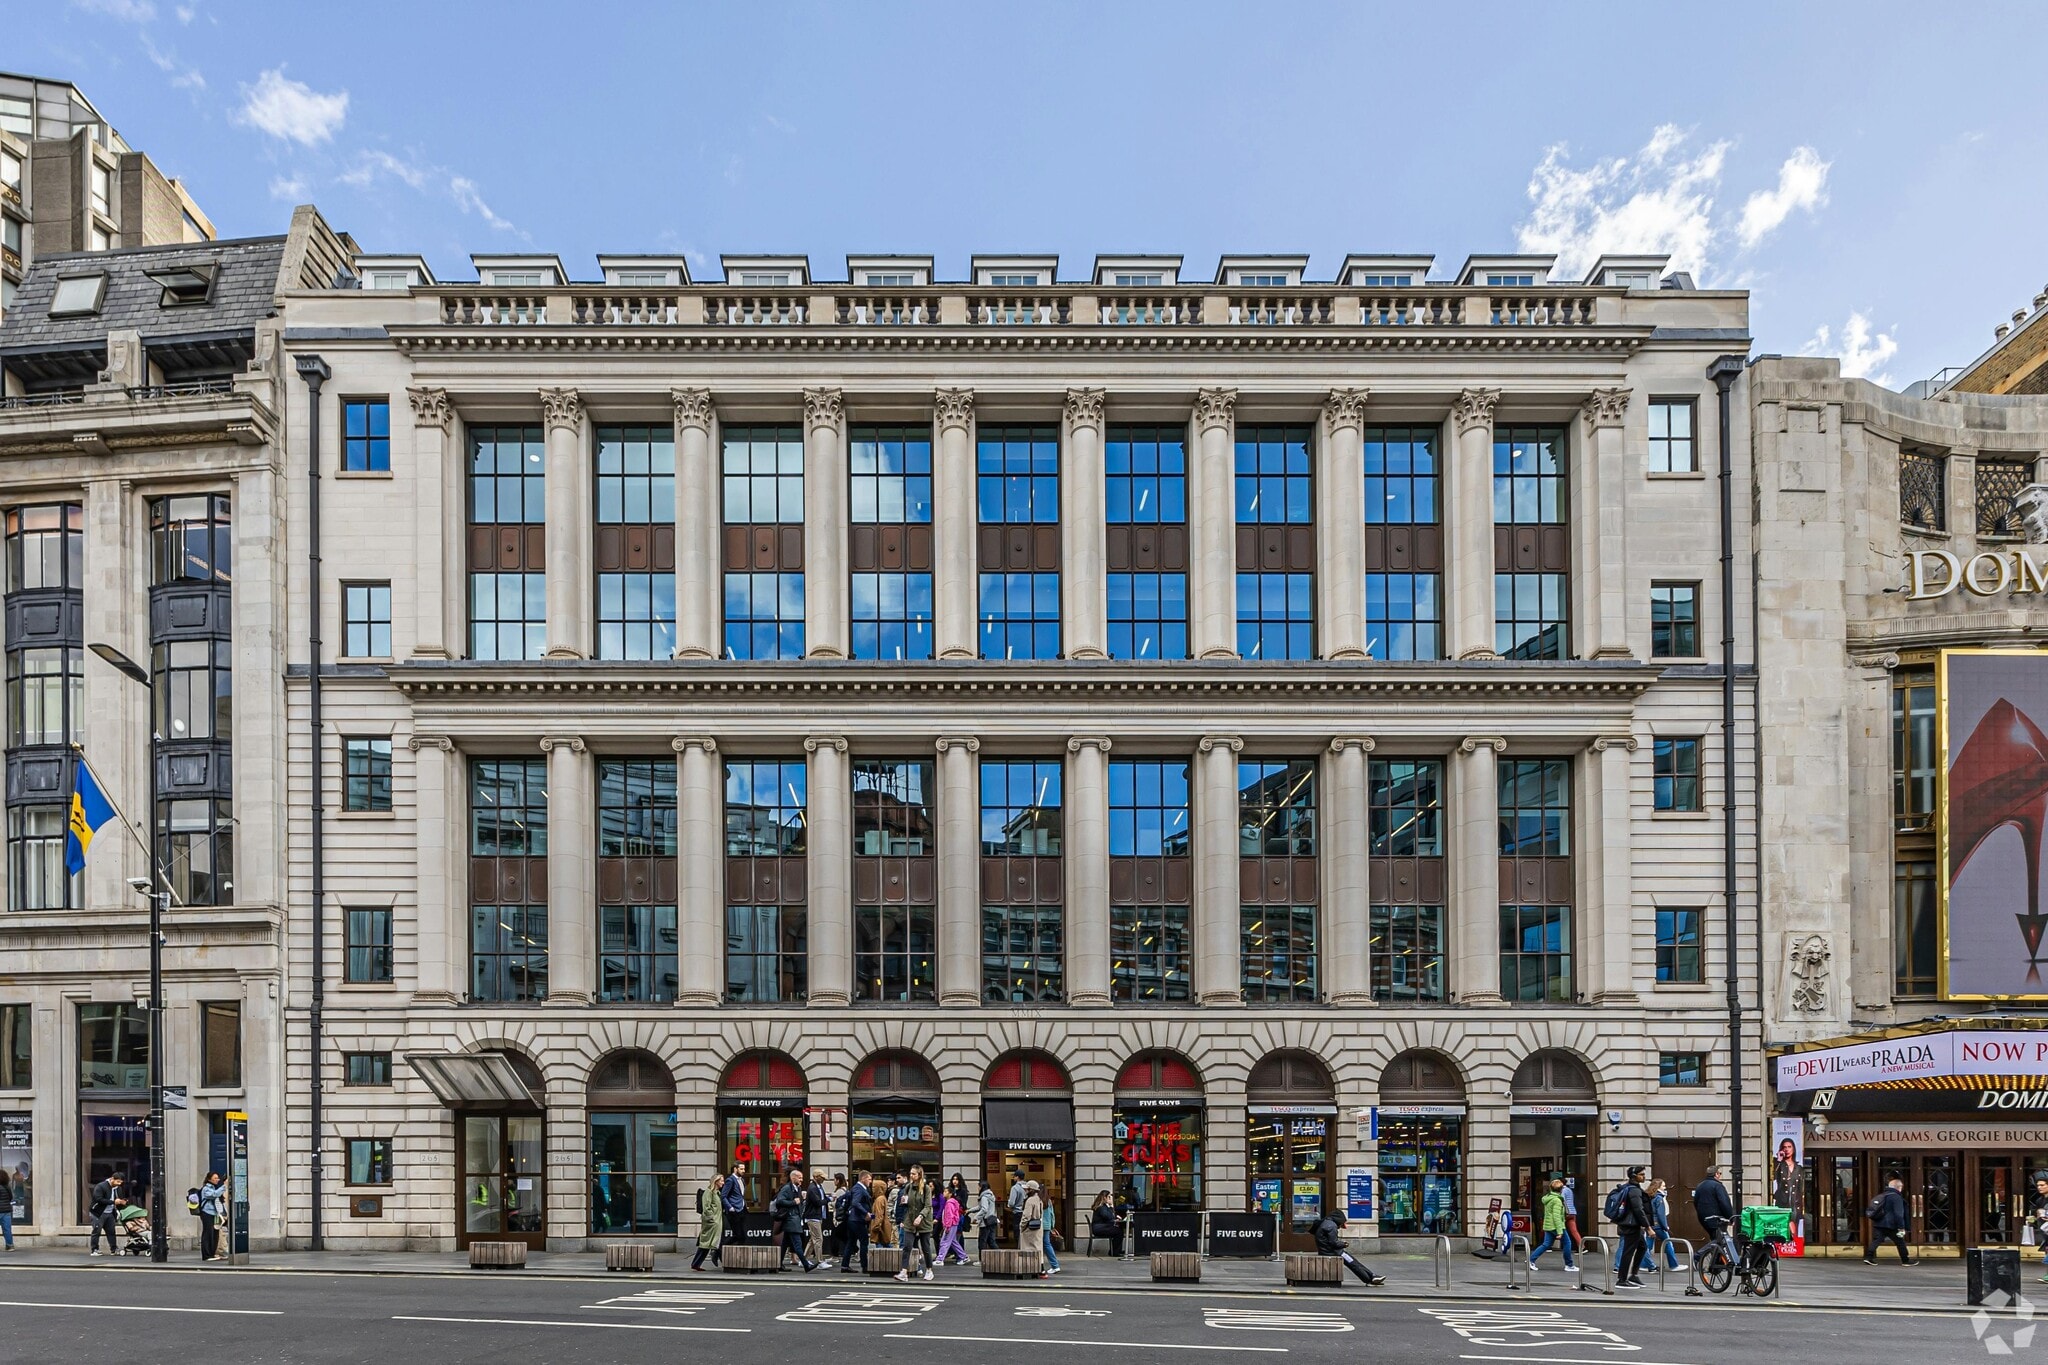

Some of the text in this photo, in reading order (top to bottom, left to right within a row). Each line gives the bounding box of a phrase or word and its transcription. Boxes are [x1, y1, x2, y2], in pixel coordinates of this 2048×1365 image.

[1903, 550, 2048, 601] DOM
[1962, 1042, 2026, 1061] NOW
[1783, 1044, 1935, 1081] THE DEVIL WEARS PRADA
[1888, 1065, 1902, 1073] NEW
[1904, 1062, 1935, 1072] MUSICAL
[739, 1123, 794, 1140] FIVE
[1127, 1122, 1182, 1140] FIVE
[1804, 1131, 1859, 1141] ANESSA
[1862, 1131, 1934, 1142] WILLIAMS,
[1937, 1131, 2001, 1141] GEORGIE
[735, 1144, 804, 1162] GUYS
[1122, 1144, 1191, 1164] GUYS
[579, 1289, 755, 1315] ONLY
[775, 1291, 950, 1325] AHEAD
[1200, 1307, 1356, 1333] AND
[1417, 1308, 1643, 1351] BUSES
